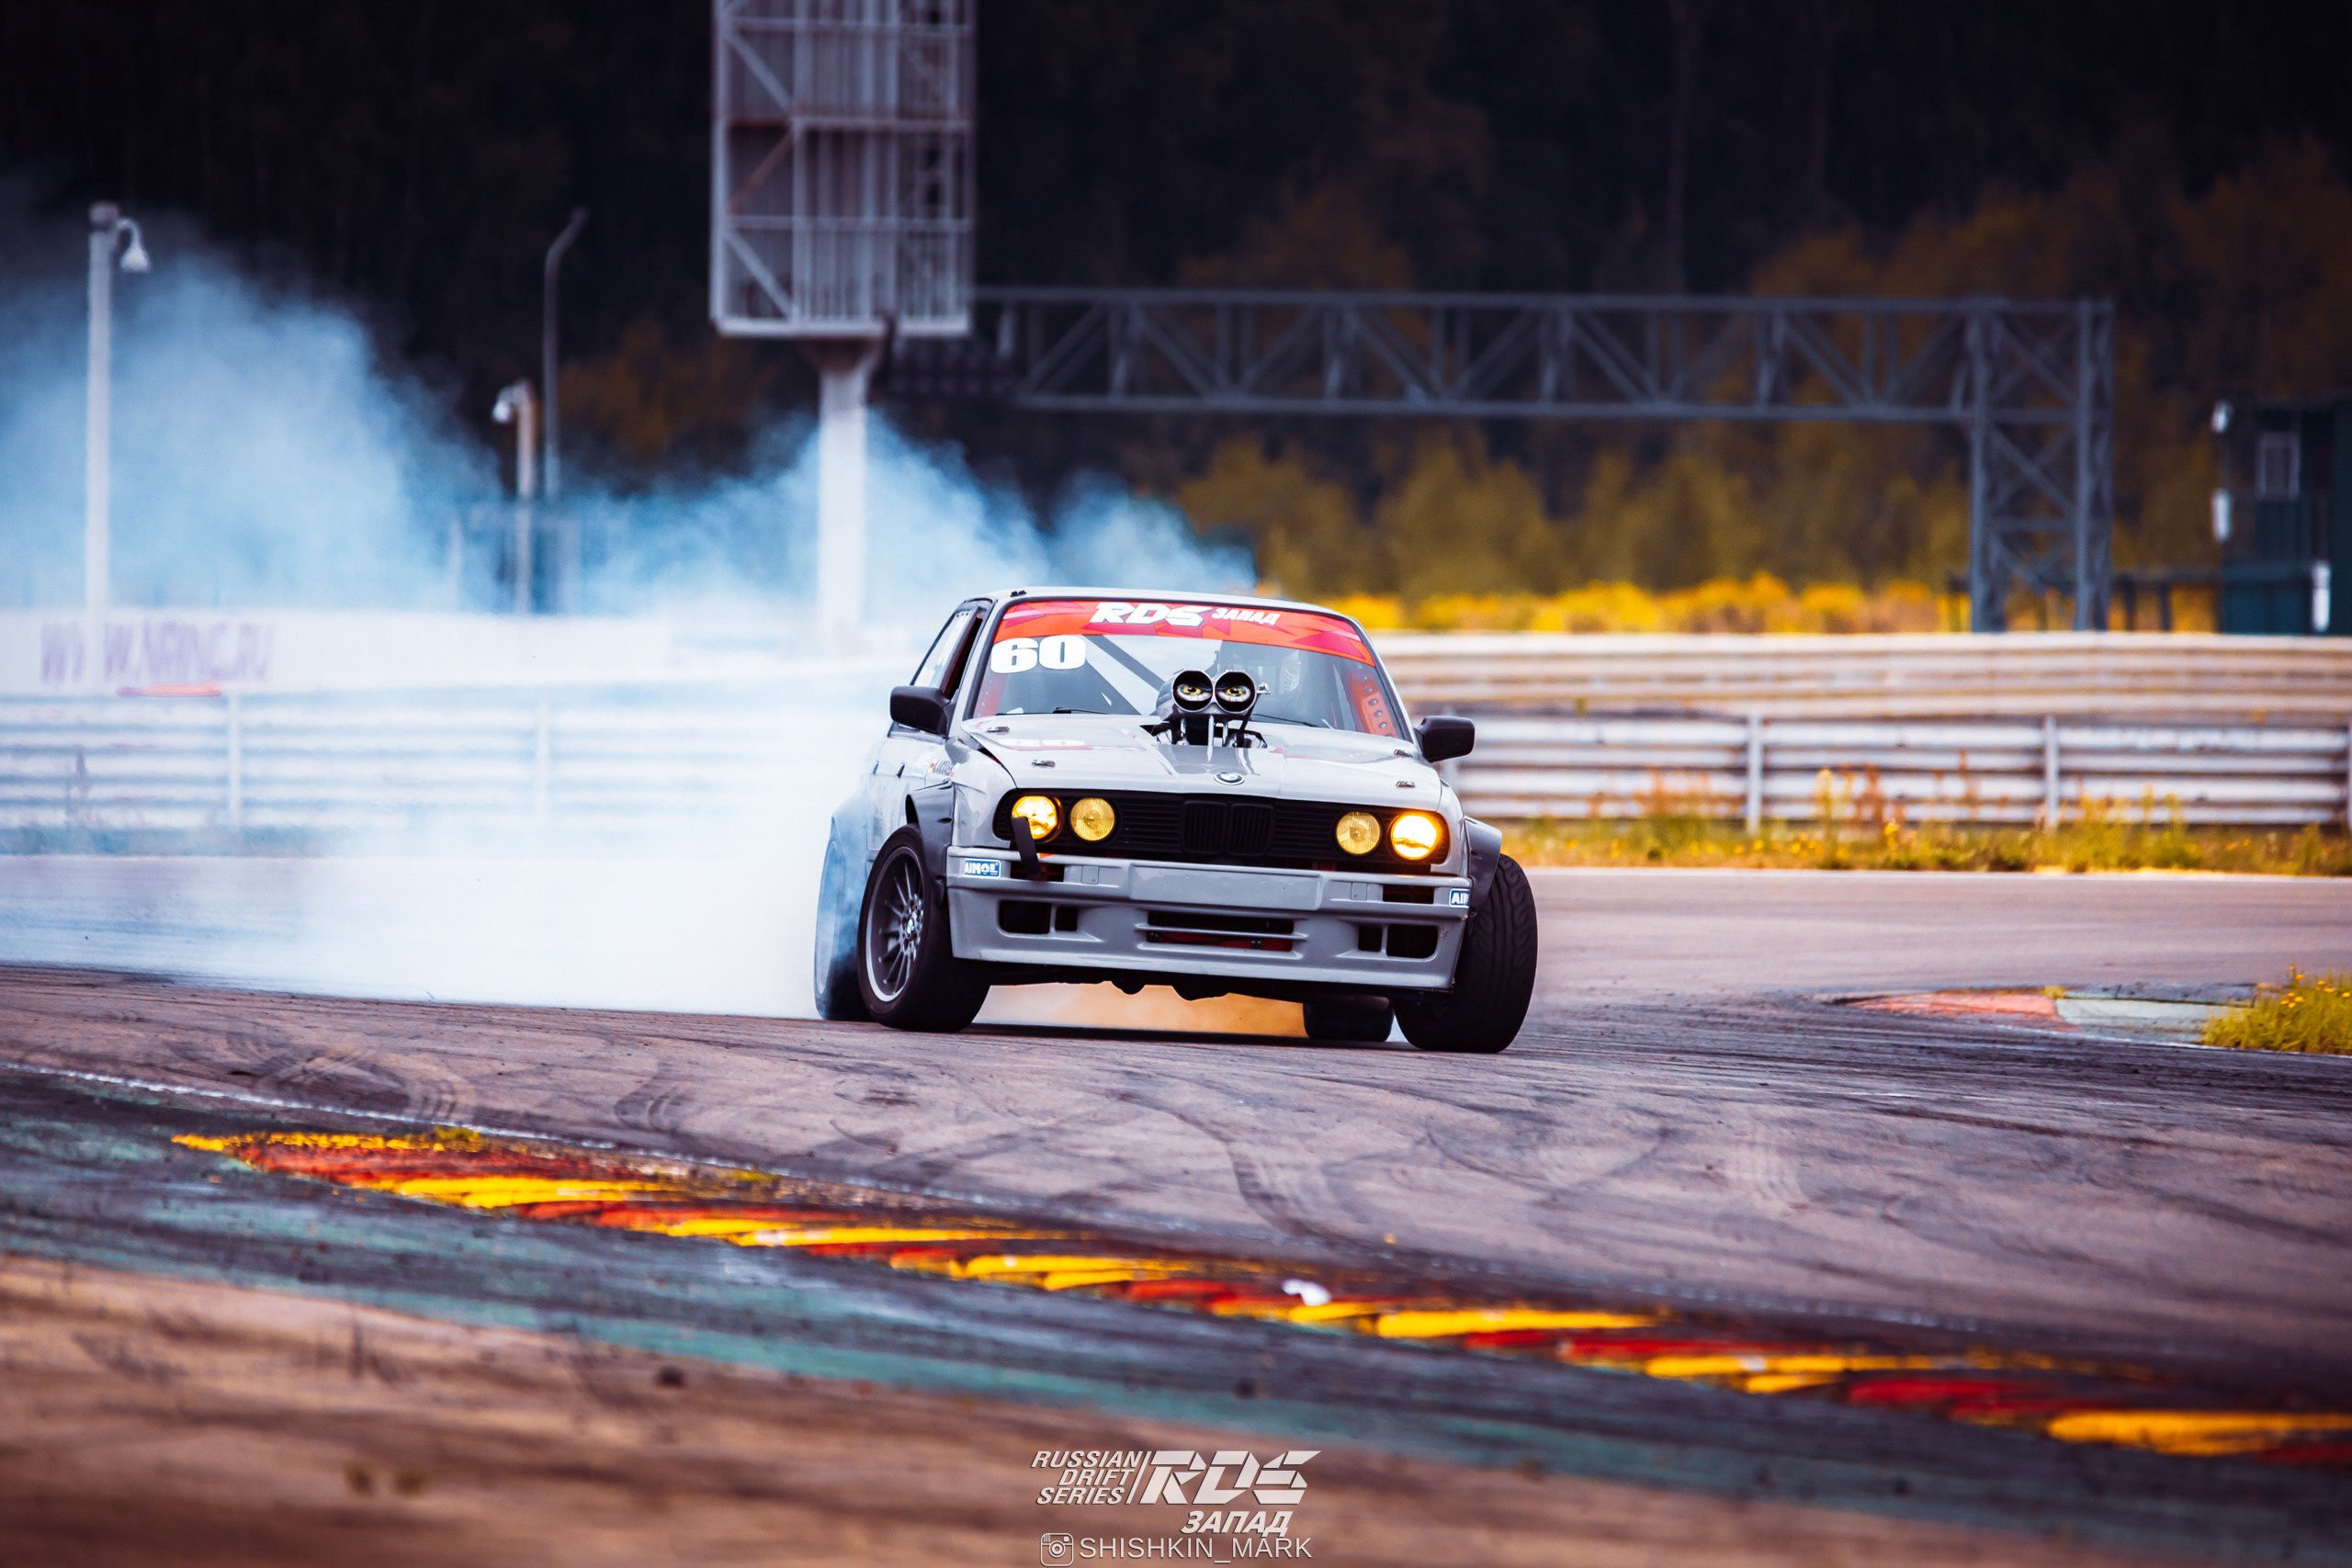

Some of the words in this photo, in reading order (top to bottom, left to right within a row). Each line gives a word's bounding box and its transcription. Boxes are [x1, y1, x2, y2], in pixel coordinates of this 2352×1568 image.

[1089, 601, 1214, 627] RDS
[1211, 607, 1282, 626] ЗАПАД
[989, 635, 1087, 673] 60
